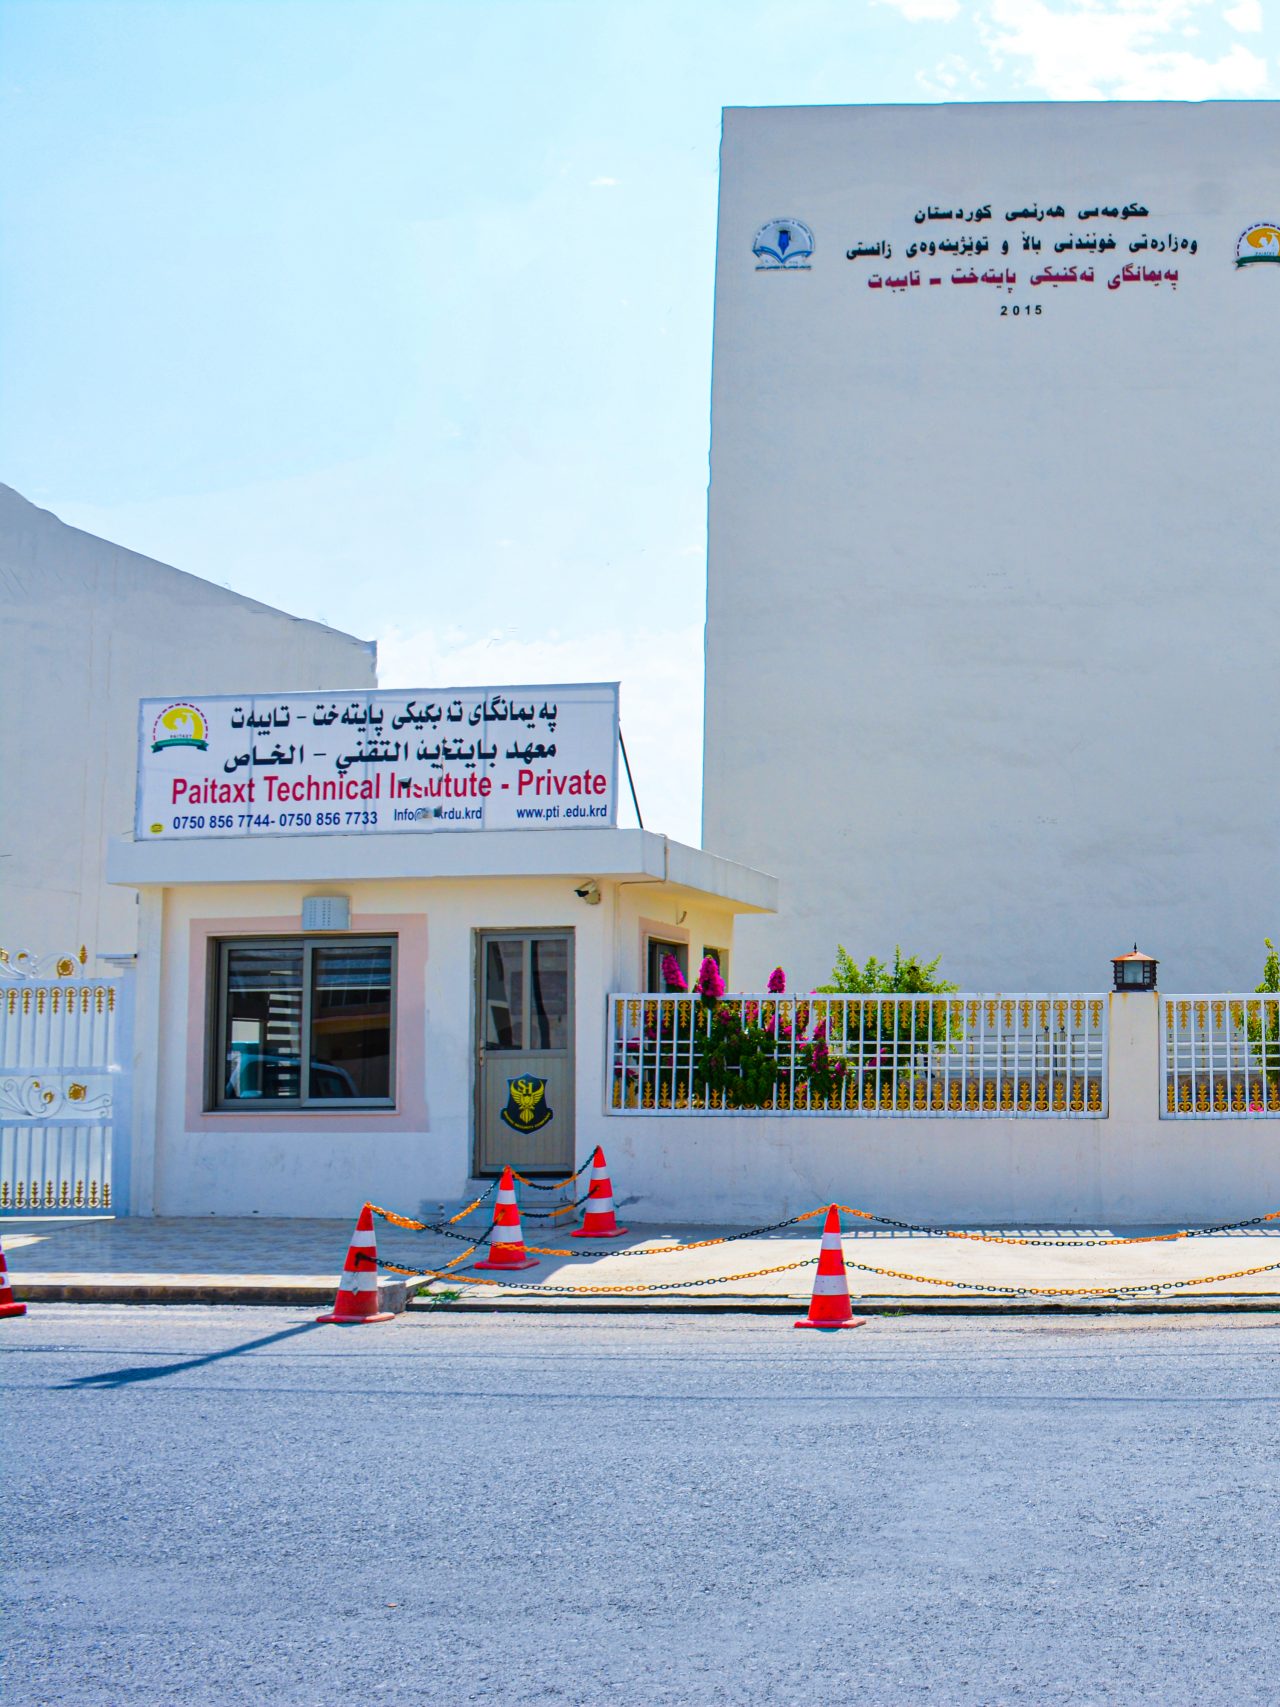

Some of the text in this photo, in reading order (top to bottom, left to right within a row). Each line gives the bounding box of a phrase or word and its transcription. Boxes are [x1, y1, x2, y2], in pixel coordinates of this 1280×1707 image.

[1000, 304, 1041, 316] 2015
[172, 778, 255, 804] Paitaxt
[264, 774, 380, 801] Technical
[518, 769, 606, 795] Private
[173, 815, 204, 830] 0750
[209, 814, 233, 829] 856
[280, 812, 311, 827] 0750
[317, 811, 340, 826] 856
[346, 810, 377, 825] 7733
